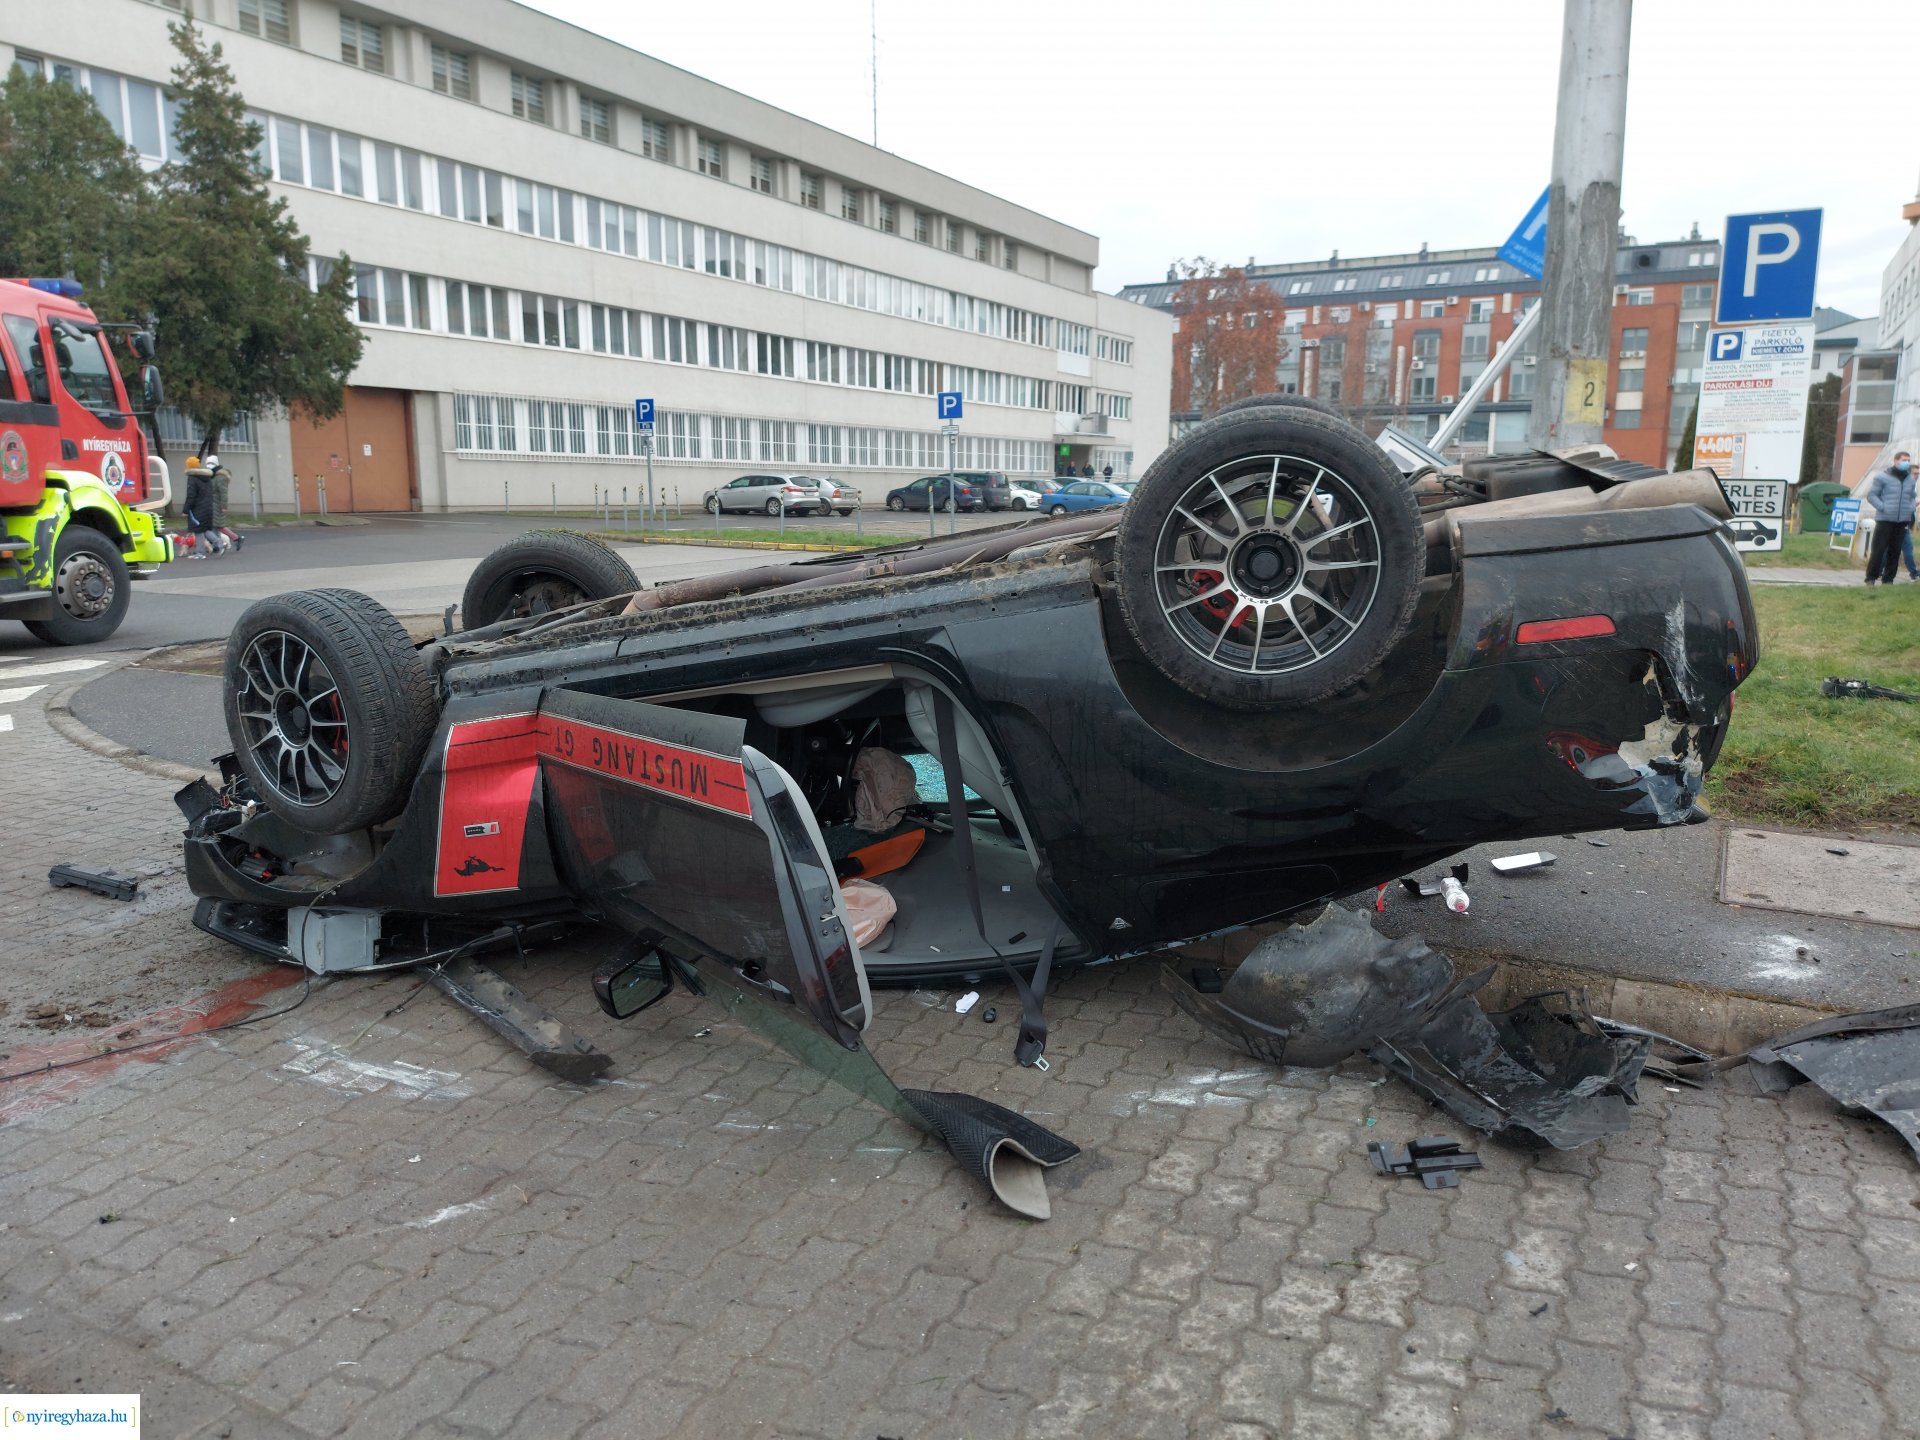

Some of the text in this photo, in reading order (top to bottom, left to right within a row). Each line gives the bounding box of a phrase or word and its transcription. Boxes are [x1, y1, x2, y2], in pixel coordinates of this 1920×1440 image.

[1742, 223, 1800, 298] P
[1716, 334, 1738, 359] P
[1754, 337, 1803, 346] PARKOLÓ
[1584, 381, 1594, 406] 2
[1704, 380, 1754, 391] PARKOLÁSI
[640, 402, 650, 420] P
[943, 396, 957, 416] P
[83, 436, 132, 453] NYÍREGYHÁZA
[1722, 481, 1779, 498] ÉRLET-
[1730, 501, 1776, 514] NTES
[555, 727, 708, 797] MUSTANG GT
